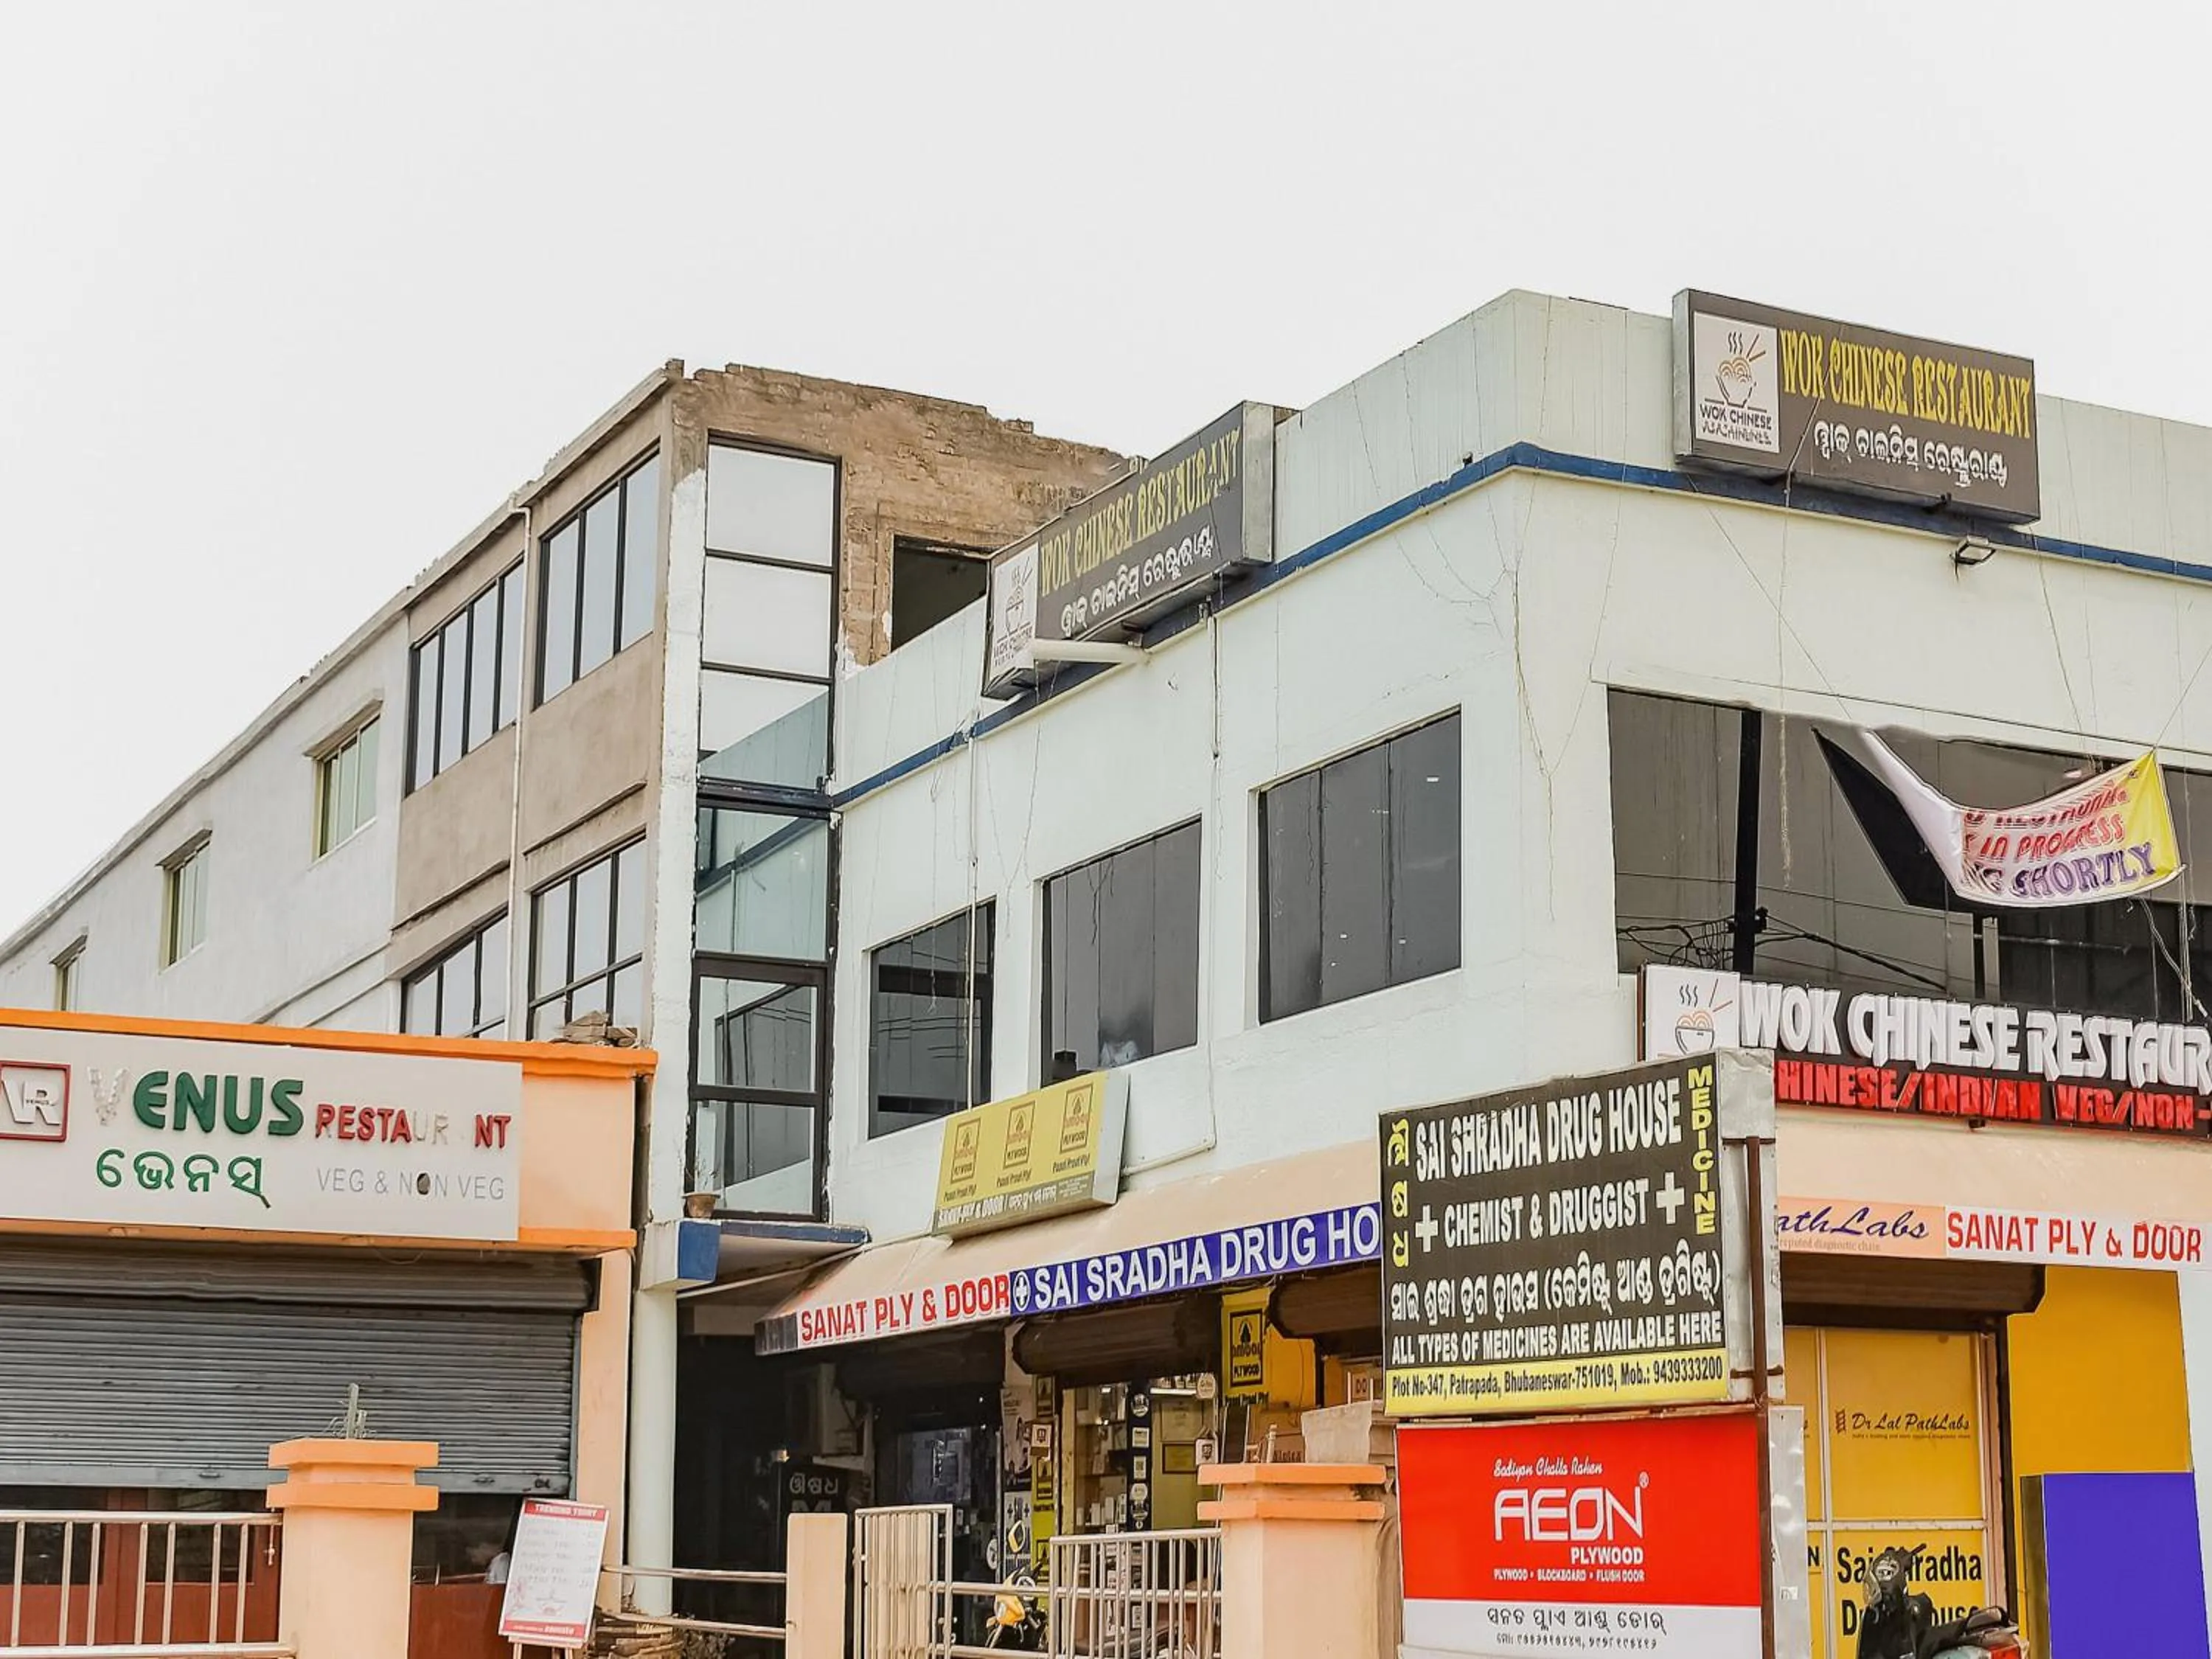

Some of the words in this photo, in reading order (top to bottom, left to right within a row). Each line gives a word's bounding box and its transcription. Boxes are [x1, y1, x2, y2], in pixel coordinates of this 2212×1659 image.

[1780, 329, 1826, 399] WOK
[1829, 337, 1907, 416] CHINESE
[1913, 354, 2031, 439] RESTAURANT
[1700, 403, 1727, 422] WOK
[1730, 409, 1772, 431] CHINESE
[1040, 529, 1071, 597] WOK
[1074, 492, 1133, 579] CHINESE
[1137, 428, 1240, 540] RESTAURANT
[1739, 981, 1840, 1054] WOK
[1848, 992, 2021, 1069] CHINESE
[2026, 1009, 2212, 1096] RESTAUR
[87, 1065, 305, 1137] VENUS
[315, 1103, 511, 1150] RESTAURNT
[1778, 1060, 2041, 1119] HINESE/INDIAN
[1416, 1119, 1446, 1182] SAI
[1451, 1105, 1542, 1178] SHRADHA
[1547, 1091, 1602, 1163] DRUG
[1608, 1077, 1682, 1153] HOUSE
[1687, 1065, 1716, 1236] MEDICINE
[317, 1167, 364, 1193] VEG
[375, 1170, 388, 1194] &
[400, 1171, 448, 1197] NON
[458, 1174, 504, 1200] VEG
[1444, 1193, 1523, 1248] CHEMIST
[1529, 1192, 1543, 1239] &
[1549, 1178, 1649, 1237] DRUGGIST
[1778, 1206, 1930, 1239] athLabs
[1947, 1211, 2040, 1253] SANAT
[2048, 1217, 2098, 1256] PLY
[2106, 1225, 2122, 1258] &
[2134, 1222, 2202, 1263] DOOR
[1034, 1267, 1079, 1310] SAI
[1086, 1237, 1213, 1301] SRADHA
[1220, 1217, 1318, 1278] DRUG
[1326, 1205, 1381, 1262] HO
[801, 1300, 866, 1342] SANAT
[874, 1292, 914, 1332] PLY
[922, 1289, 937, 1322] &
[945, 1275, 1009, 1318] DOOR
[1391, 1335, 1416, 1365] ALL
[1418, 1332, 1458, 1363] TYPES
[1462, 1330, 1479, 1360] OF
[1483, 1324, 1557, 1360] MEDICINES
[1560, 1322, 1590, 1355] ARE
[1593, 1315, 1674, 1352] AVAILABLE
[1680, 1310, 1721, 1345] HERE
[1391, 1374, 1412, 1398] Plot
[1450, 1370, 1501, 1399] Patrapada,
[1504, 1363, 1617, 1393] Bhubaneswar-751019,
[1653, 1354, 1722, 1384] 9439333200
[1852, 1413, 1871, 1430] Dr
[1875, 1413, 1901, 1430] Lal
[1905, 1413, 1969, 1430] PathLabs
[1495, 1486, 1644, 1541] AEON
[1494, 1568, 1528, 1581] PLYWOOD
[1537, 1568, 1586, 1582] BLOCKBOARD
[1596, 1569, 1621, 1582] FLUSH
[1622, 1569, 1644, 1582] DOOR
[1571, 1547, 1644, 1565] PLYWOOD
